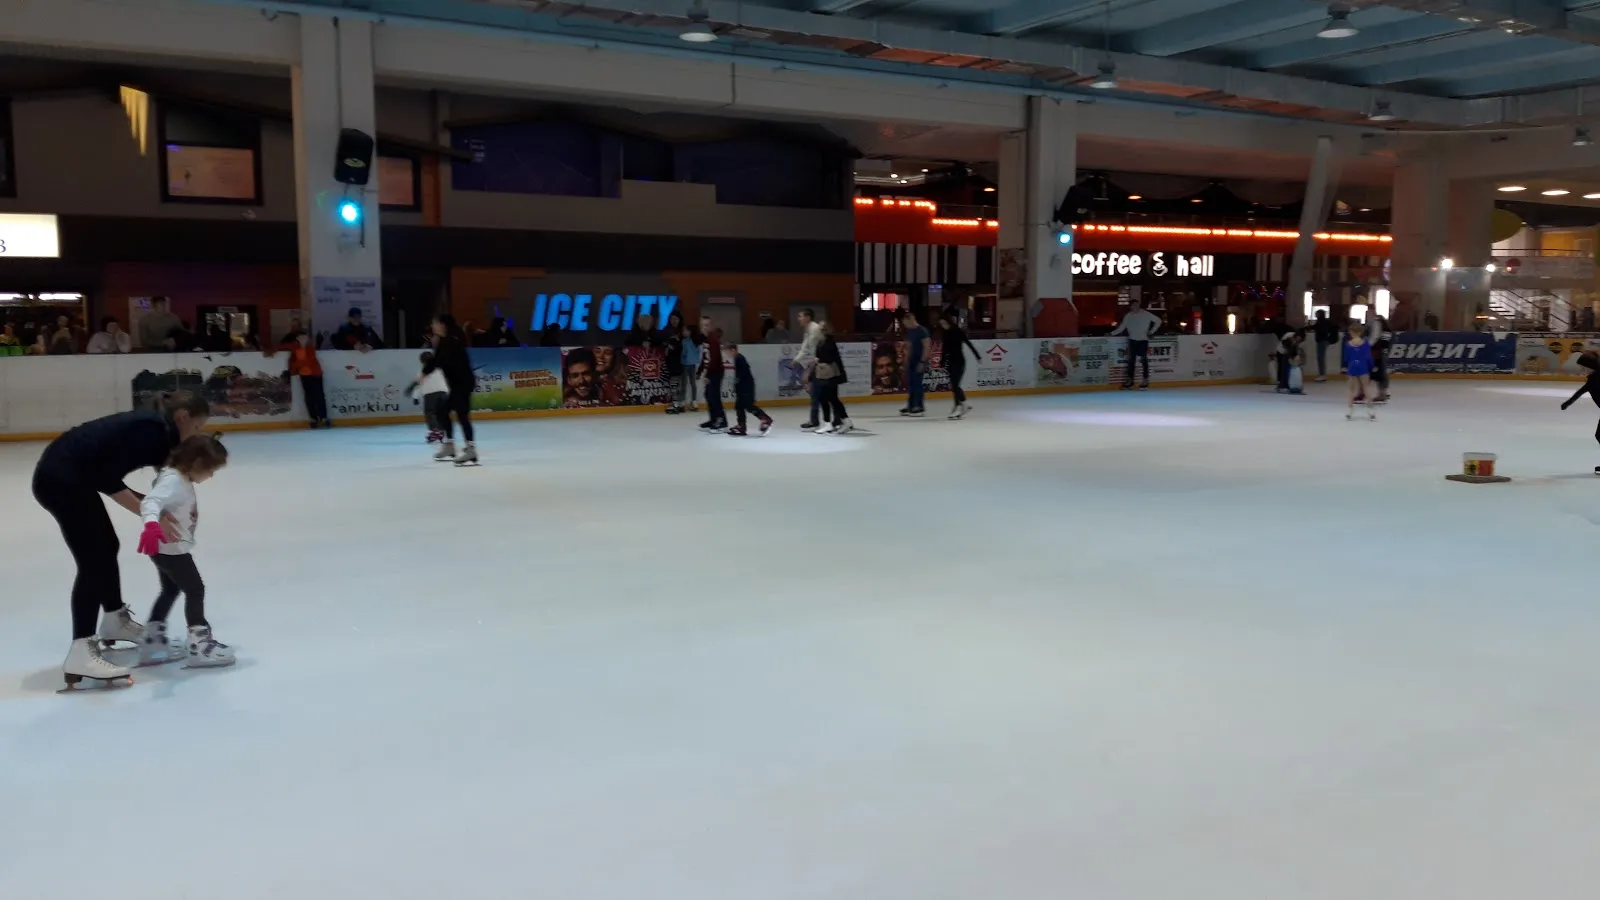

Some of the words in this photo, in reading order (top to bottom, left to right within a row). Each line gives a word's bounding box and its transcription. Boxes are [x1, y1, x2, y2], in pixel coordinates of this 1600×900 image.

[1071, 252, 1142, 276] coffee
[1176, 255, 1215, 277] hall
[530, 293, 592, 332] ICE
[597, 293, 679, 332] CITY
[1388, 342, 1486, 360] ВИЗИТ
